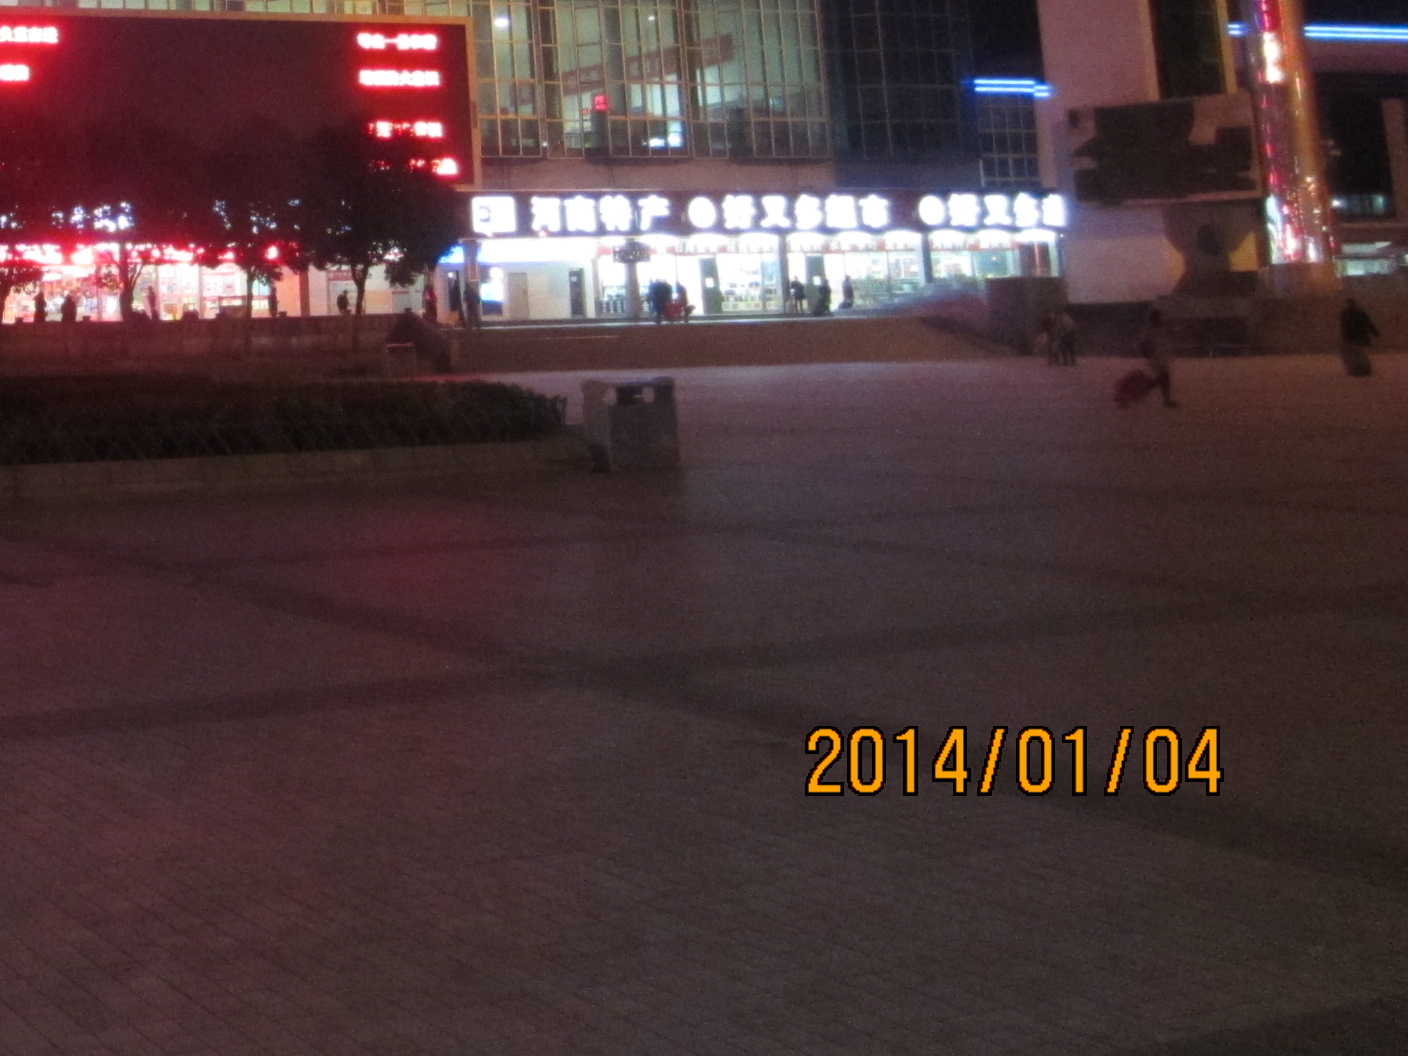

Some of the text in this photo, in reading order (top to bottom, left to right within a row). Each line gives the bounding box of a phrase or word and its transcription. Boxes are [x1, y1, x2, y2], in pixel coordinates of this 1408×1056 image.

[531, 194, 671, 233] 河南特产
[722, 193, 891, 231] 好又多超市
